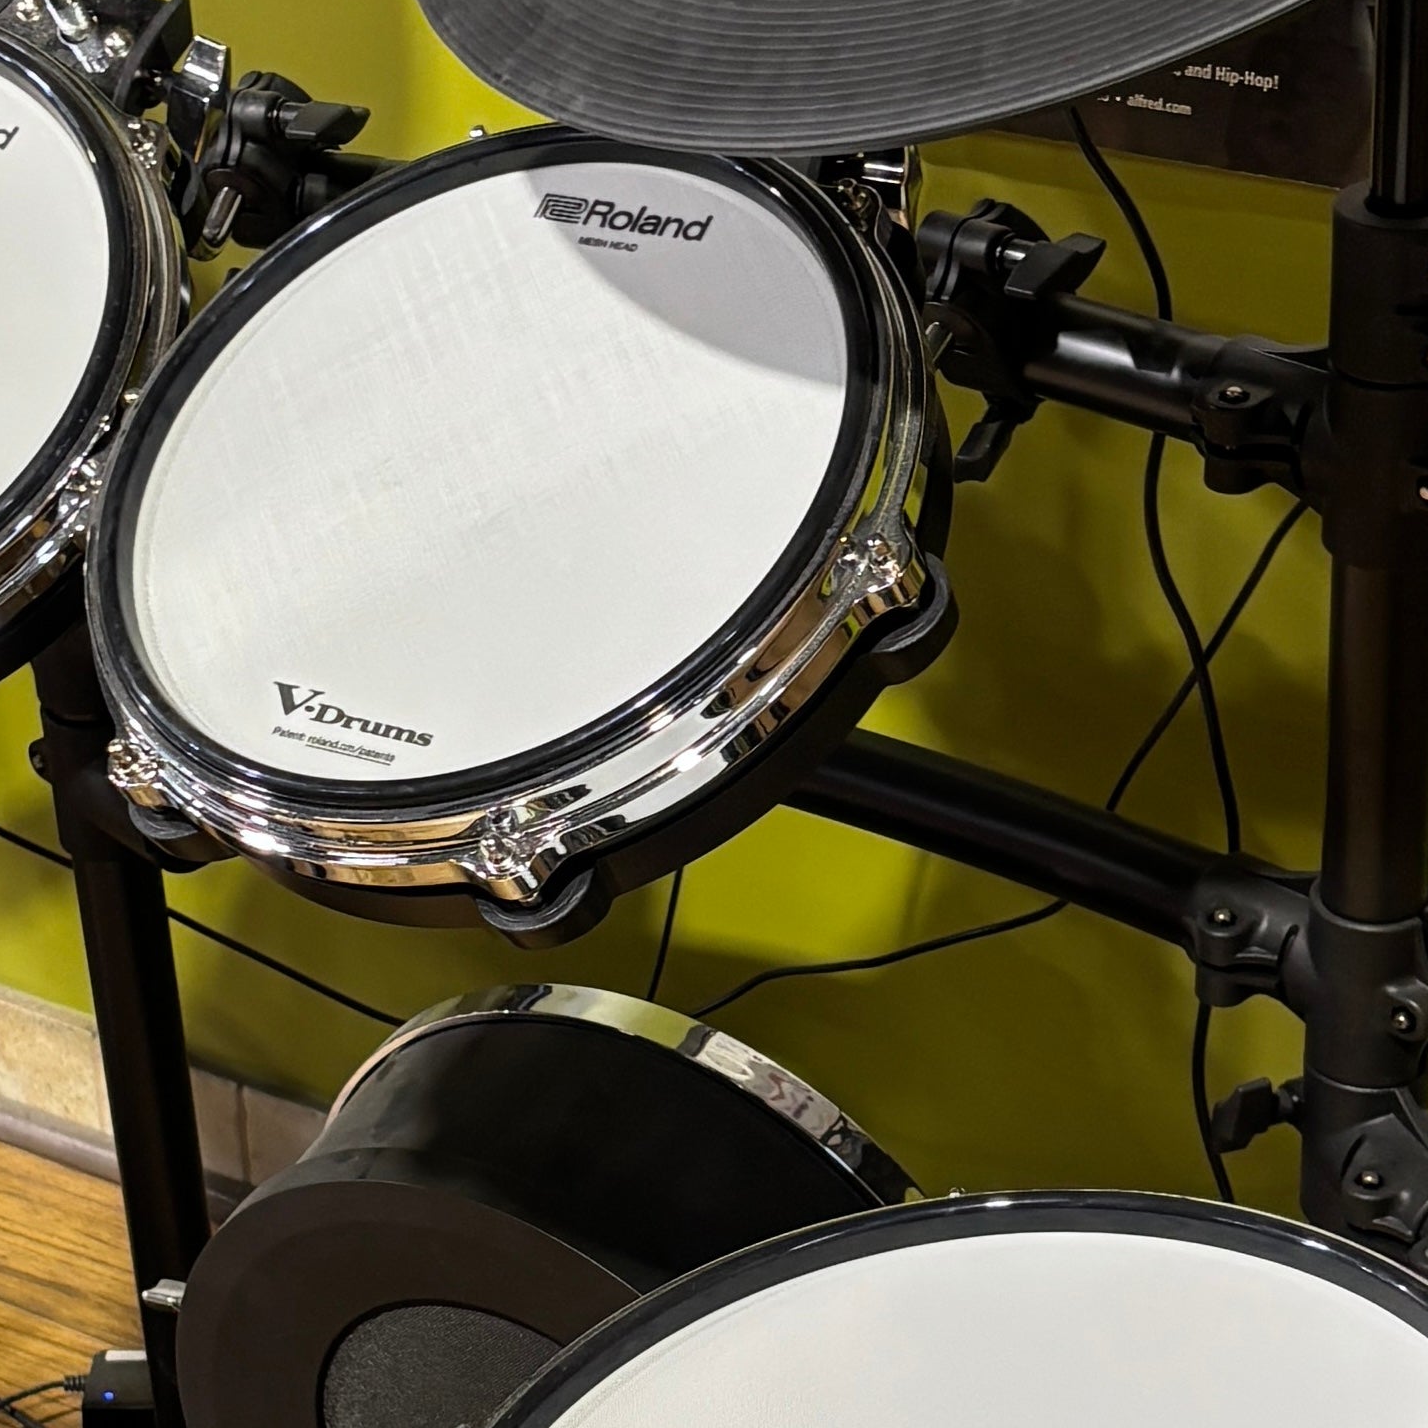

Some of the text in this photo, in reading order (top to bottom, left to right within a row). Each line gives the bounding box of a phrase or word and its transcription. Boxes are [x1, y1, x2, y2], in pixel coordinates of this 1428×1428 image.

[1184, 64, 1280, 93] and Hip-Hop!
[1126, 94, 1192, 116] alfred.com
[582, 198, 714, 242] Roland
